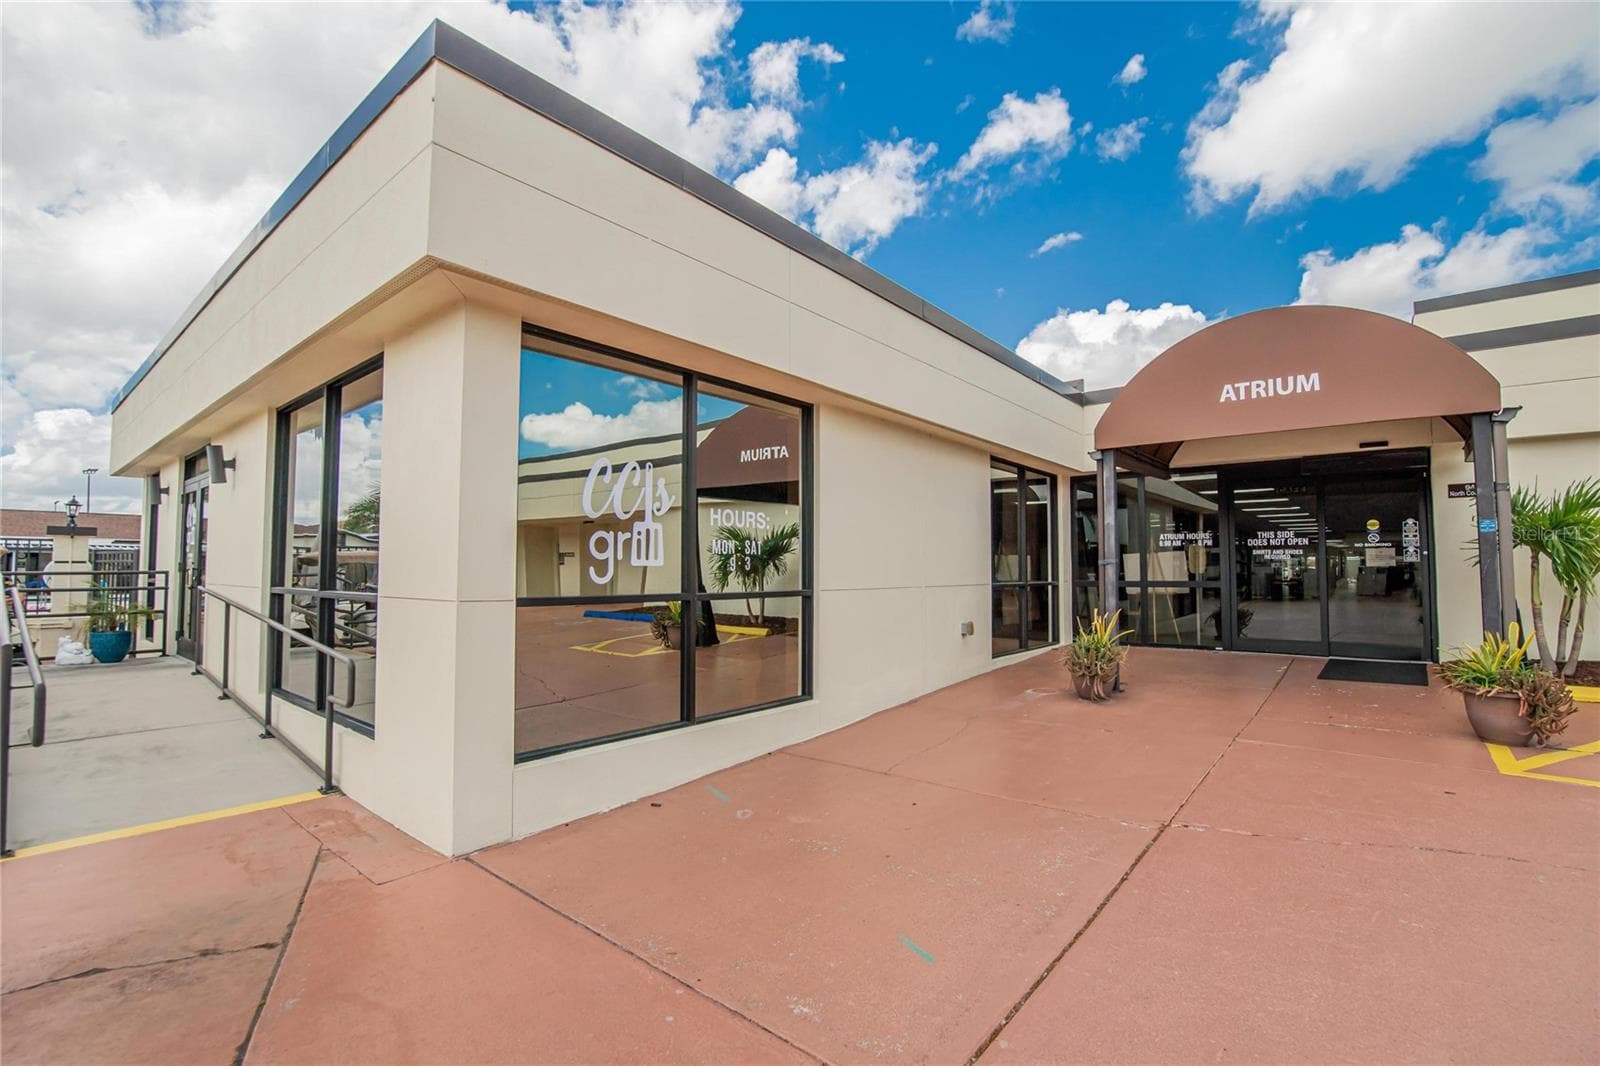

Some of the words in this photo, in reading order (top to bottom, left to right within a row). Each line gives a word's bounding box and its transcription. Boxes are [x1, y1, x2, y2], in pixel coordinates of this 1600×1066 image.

[1219, 372, 1321, 402] ATRIUM
[709, 507, 770, 530] HOURS:
[1247, 538, 1268, 546] DOES
[1269, 538, 1286, 546] NOT
[1287, 537, 1309, 545] OPEN
[1257, 531, 1275, 539] THIS
[1276, 530, 1295, 538] SIDE
[712, 539, 736, 555] MON
[744, 540, 762, 555] SAT
[744, 556, 752, 571] 3
